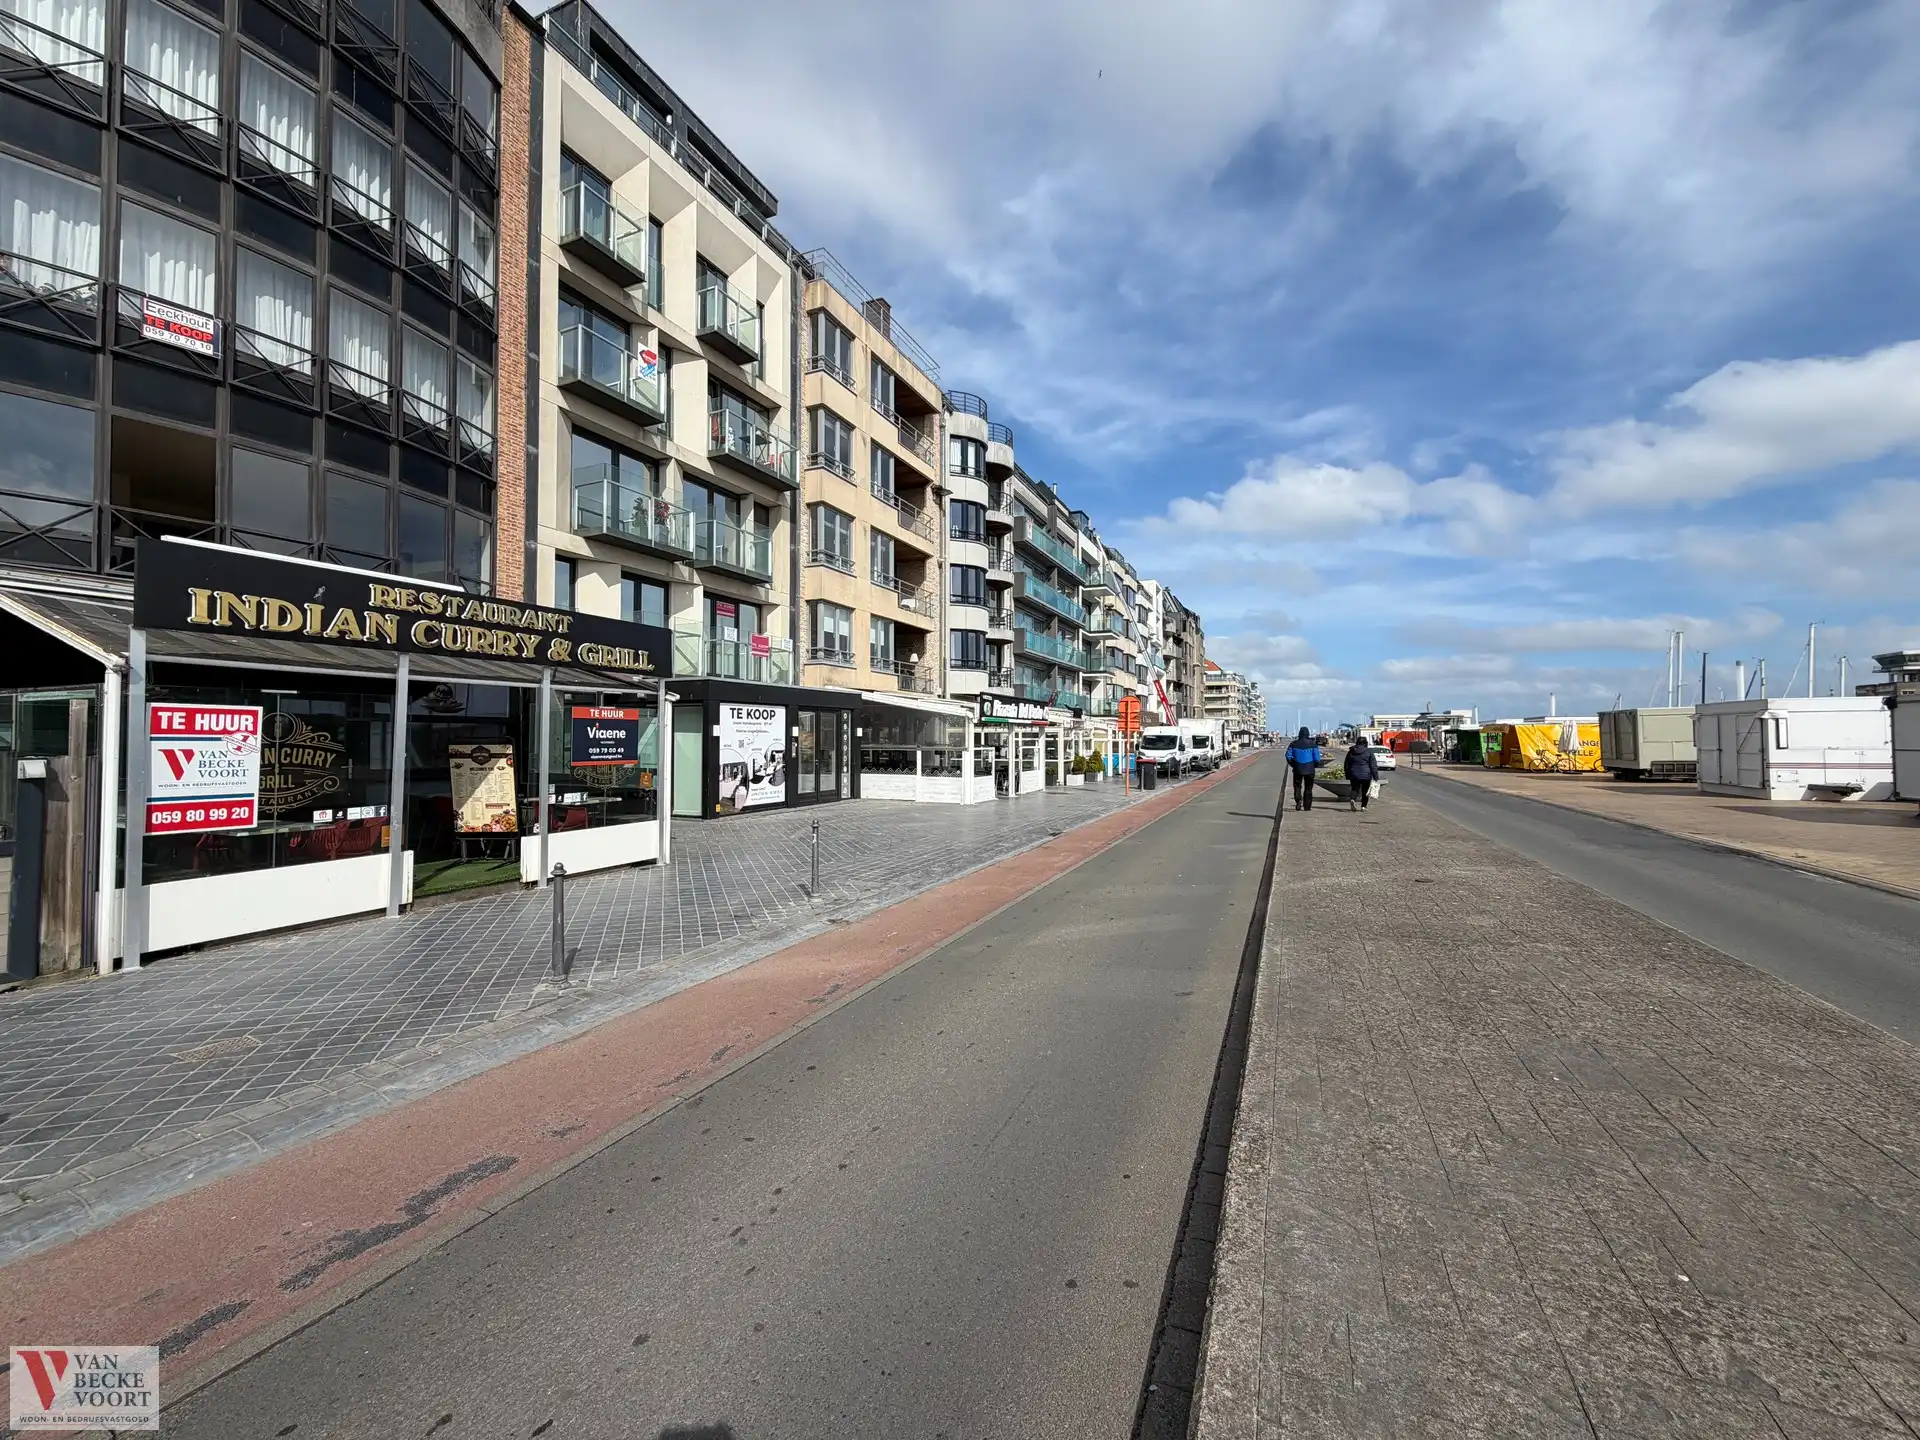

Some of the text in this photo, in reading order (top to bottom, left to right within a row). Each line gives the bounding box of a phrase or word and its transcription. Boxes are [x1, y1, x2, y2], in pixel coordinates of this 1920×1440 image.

[146, 301, 210, 330] Eeckhout
[145, 315, 166, 329] TE
[170, 322, 213, 342] KOOP
[145, 326, 212, 351] 059 70 70 10
[369, 583, 573, 634] RESTAURANT
[187, 587, 656, 671] INDIAN CURRY & GRILL
[157, 711, 254, 731] TE HUUR
[590, 709, 624, 719] TE HUUR
[729, 707, 776, 721] TE KOOP
[587, 722, 626, 739] Viaene
[199, 750, 228, 759] VAN
[280, 747, 336, 769] CURRY
[198, 760, 245, 769] BECKE
[198, 768, 249, 779] VOORT
[261, 787, 319, 805] TAURANT
[151, 806, 249, 824] 059 80 99 20
